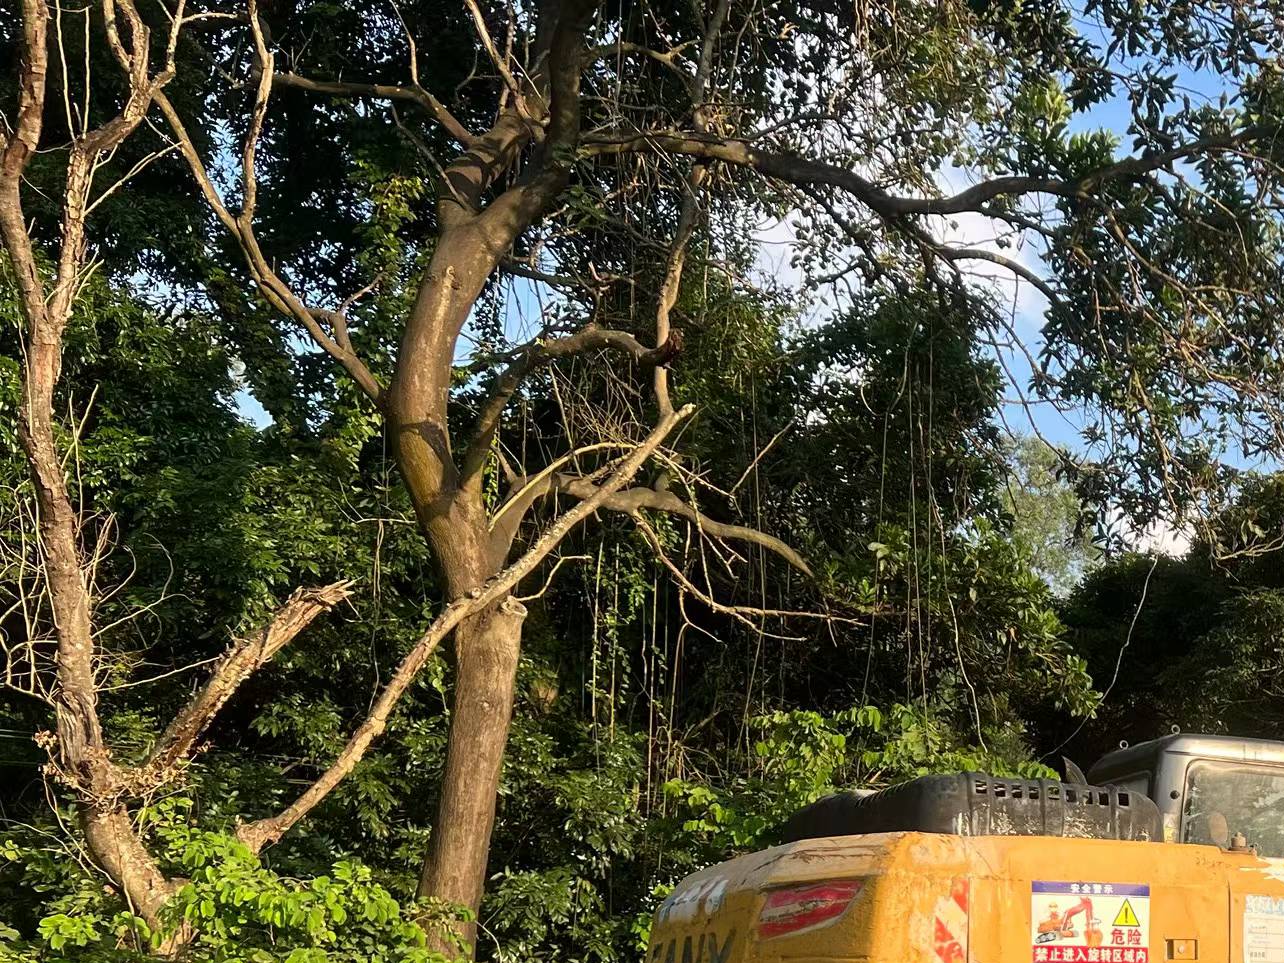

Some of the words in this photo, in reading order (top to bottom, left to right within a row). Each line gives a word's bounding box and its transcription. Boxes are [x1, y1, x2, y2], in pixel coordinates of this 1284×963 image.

[1070, 883, 1114, 894] 安全警示
[1110, 928, 1142, 945] 危险
[1034, 947, 1147, 963] 禁止进入旋转区域内
